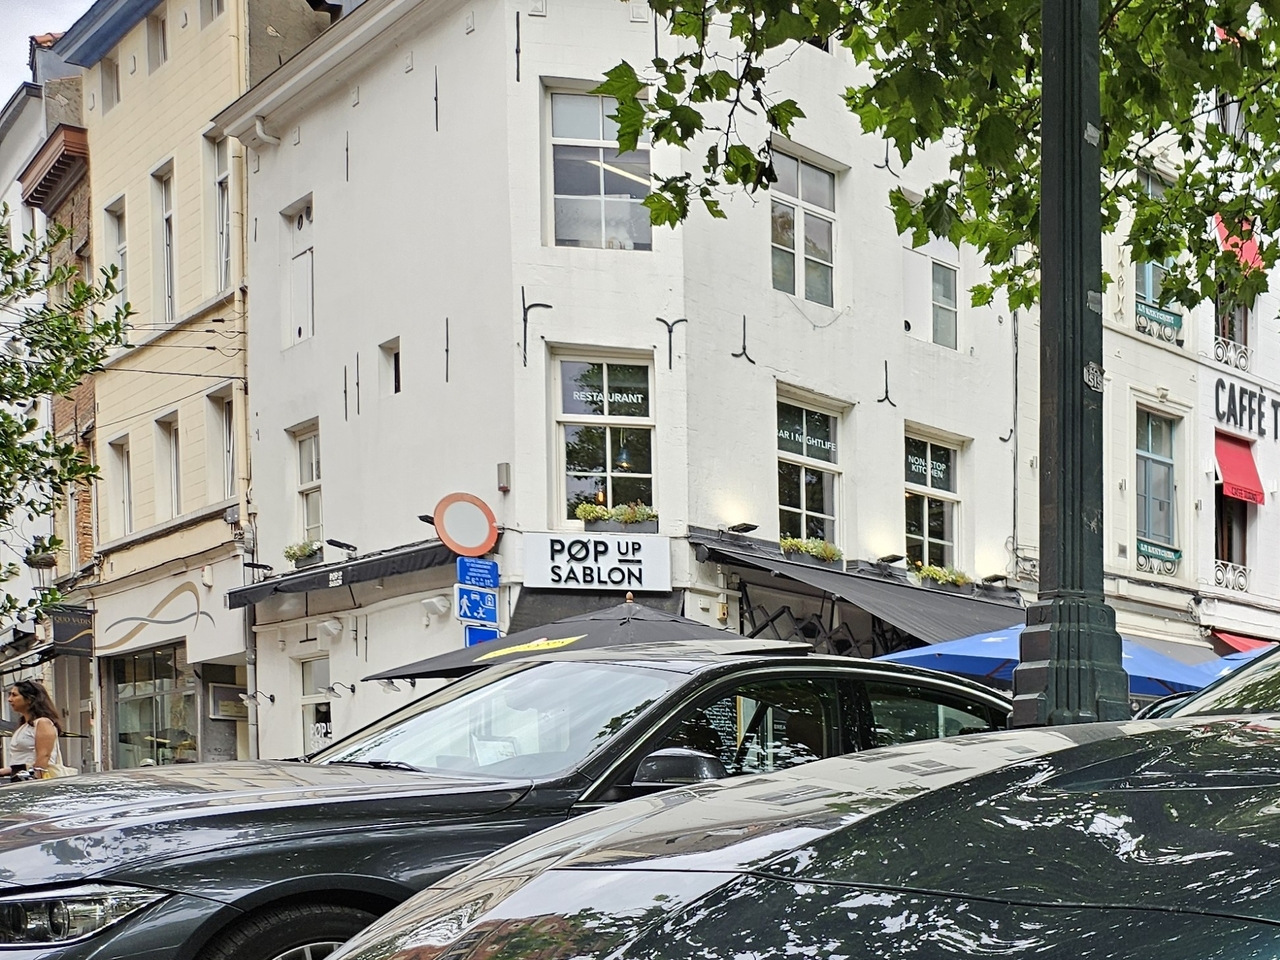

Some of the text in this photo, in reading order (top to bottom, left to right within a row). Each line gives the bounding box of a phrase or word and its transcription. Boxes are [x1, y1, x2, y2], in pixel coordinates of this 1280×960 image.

[573, 391, 644, 403] RESTAURANT
[1215, 378, 1266, 437] CAFFÈ
[617, 541, 642, 556] UP
[551, 565, 643, 586] SABLON
